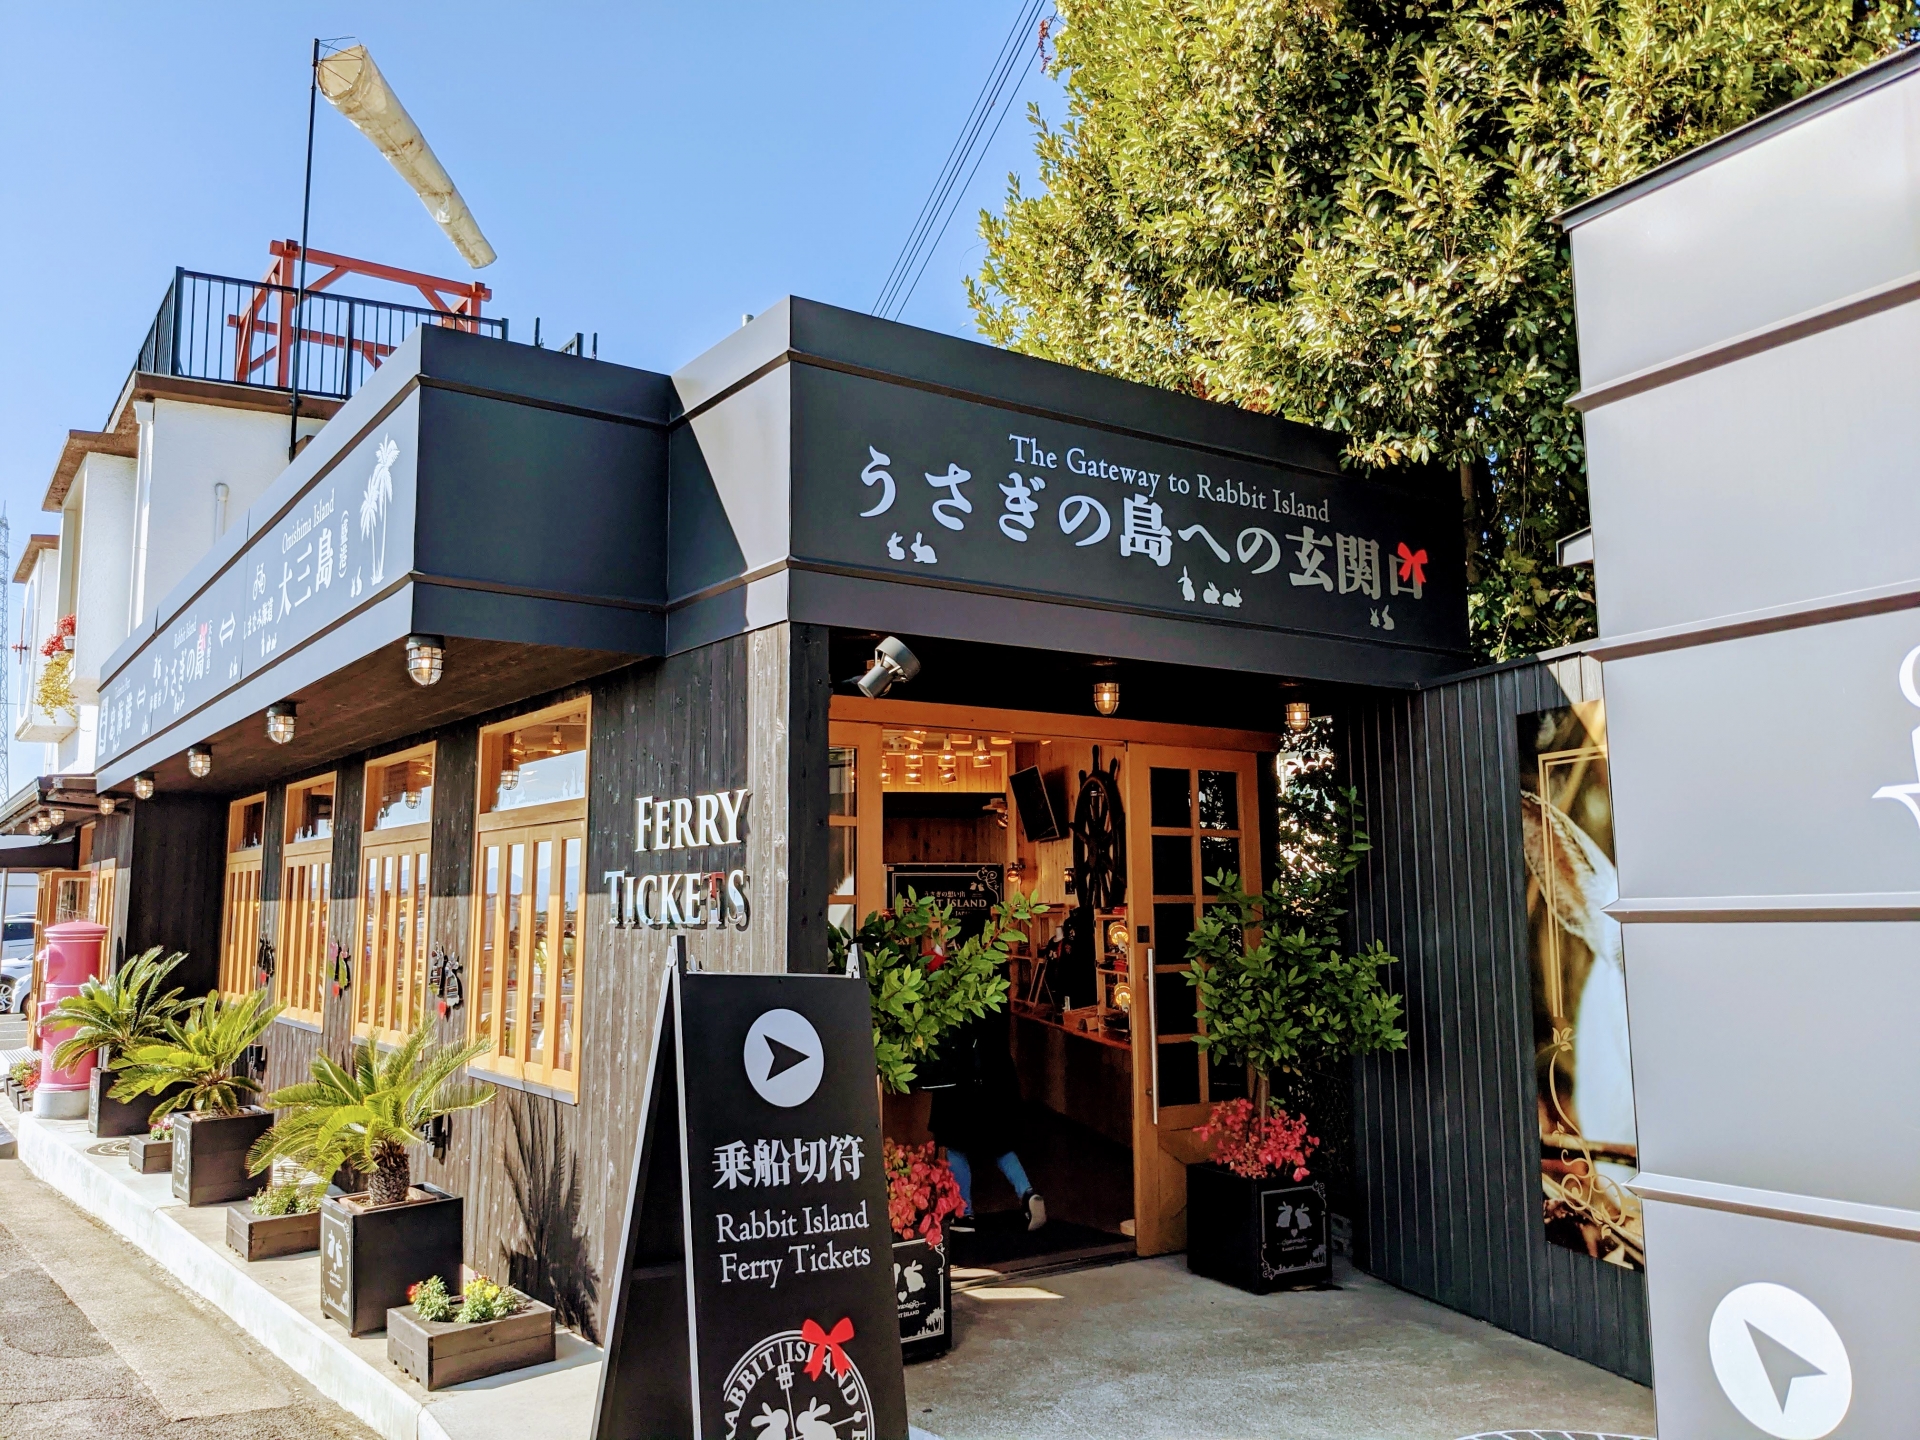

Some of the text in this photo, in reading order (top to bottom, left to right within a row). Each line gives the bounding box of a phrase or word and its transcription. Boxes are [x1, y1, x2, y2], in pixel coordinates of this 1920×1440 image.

[1009, 434, 1330, 523] The Gateway to Rabbit Island
[282, 487, 334, 554] Omishima Island
[860, 445, 1423, 600] うさぎの島への玄関口
[277, 527, 334, 625] 大三島
[635, 788, 749, 852] FERRY
[604, 869, 745, 926] TICKETS
[711, 1134, 865, 1190] 乗船切符
[716, 1200, 870, 1243] Rabbit Island
[720, 1241, 871, 1288] Ferry Tickets
